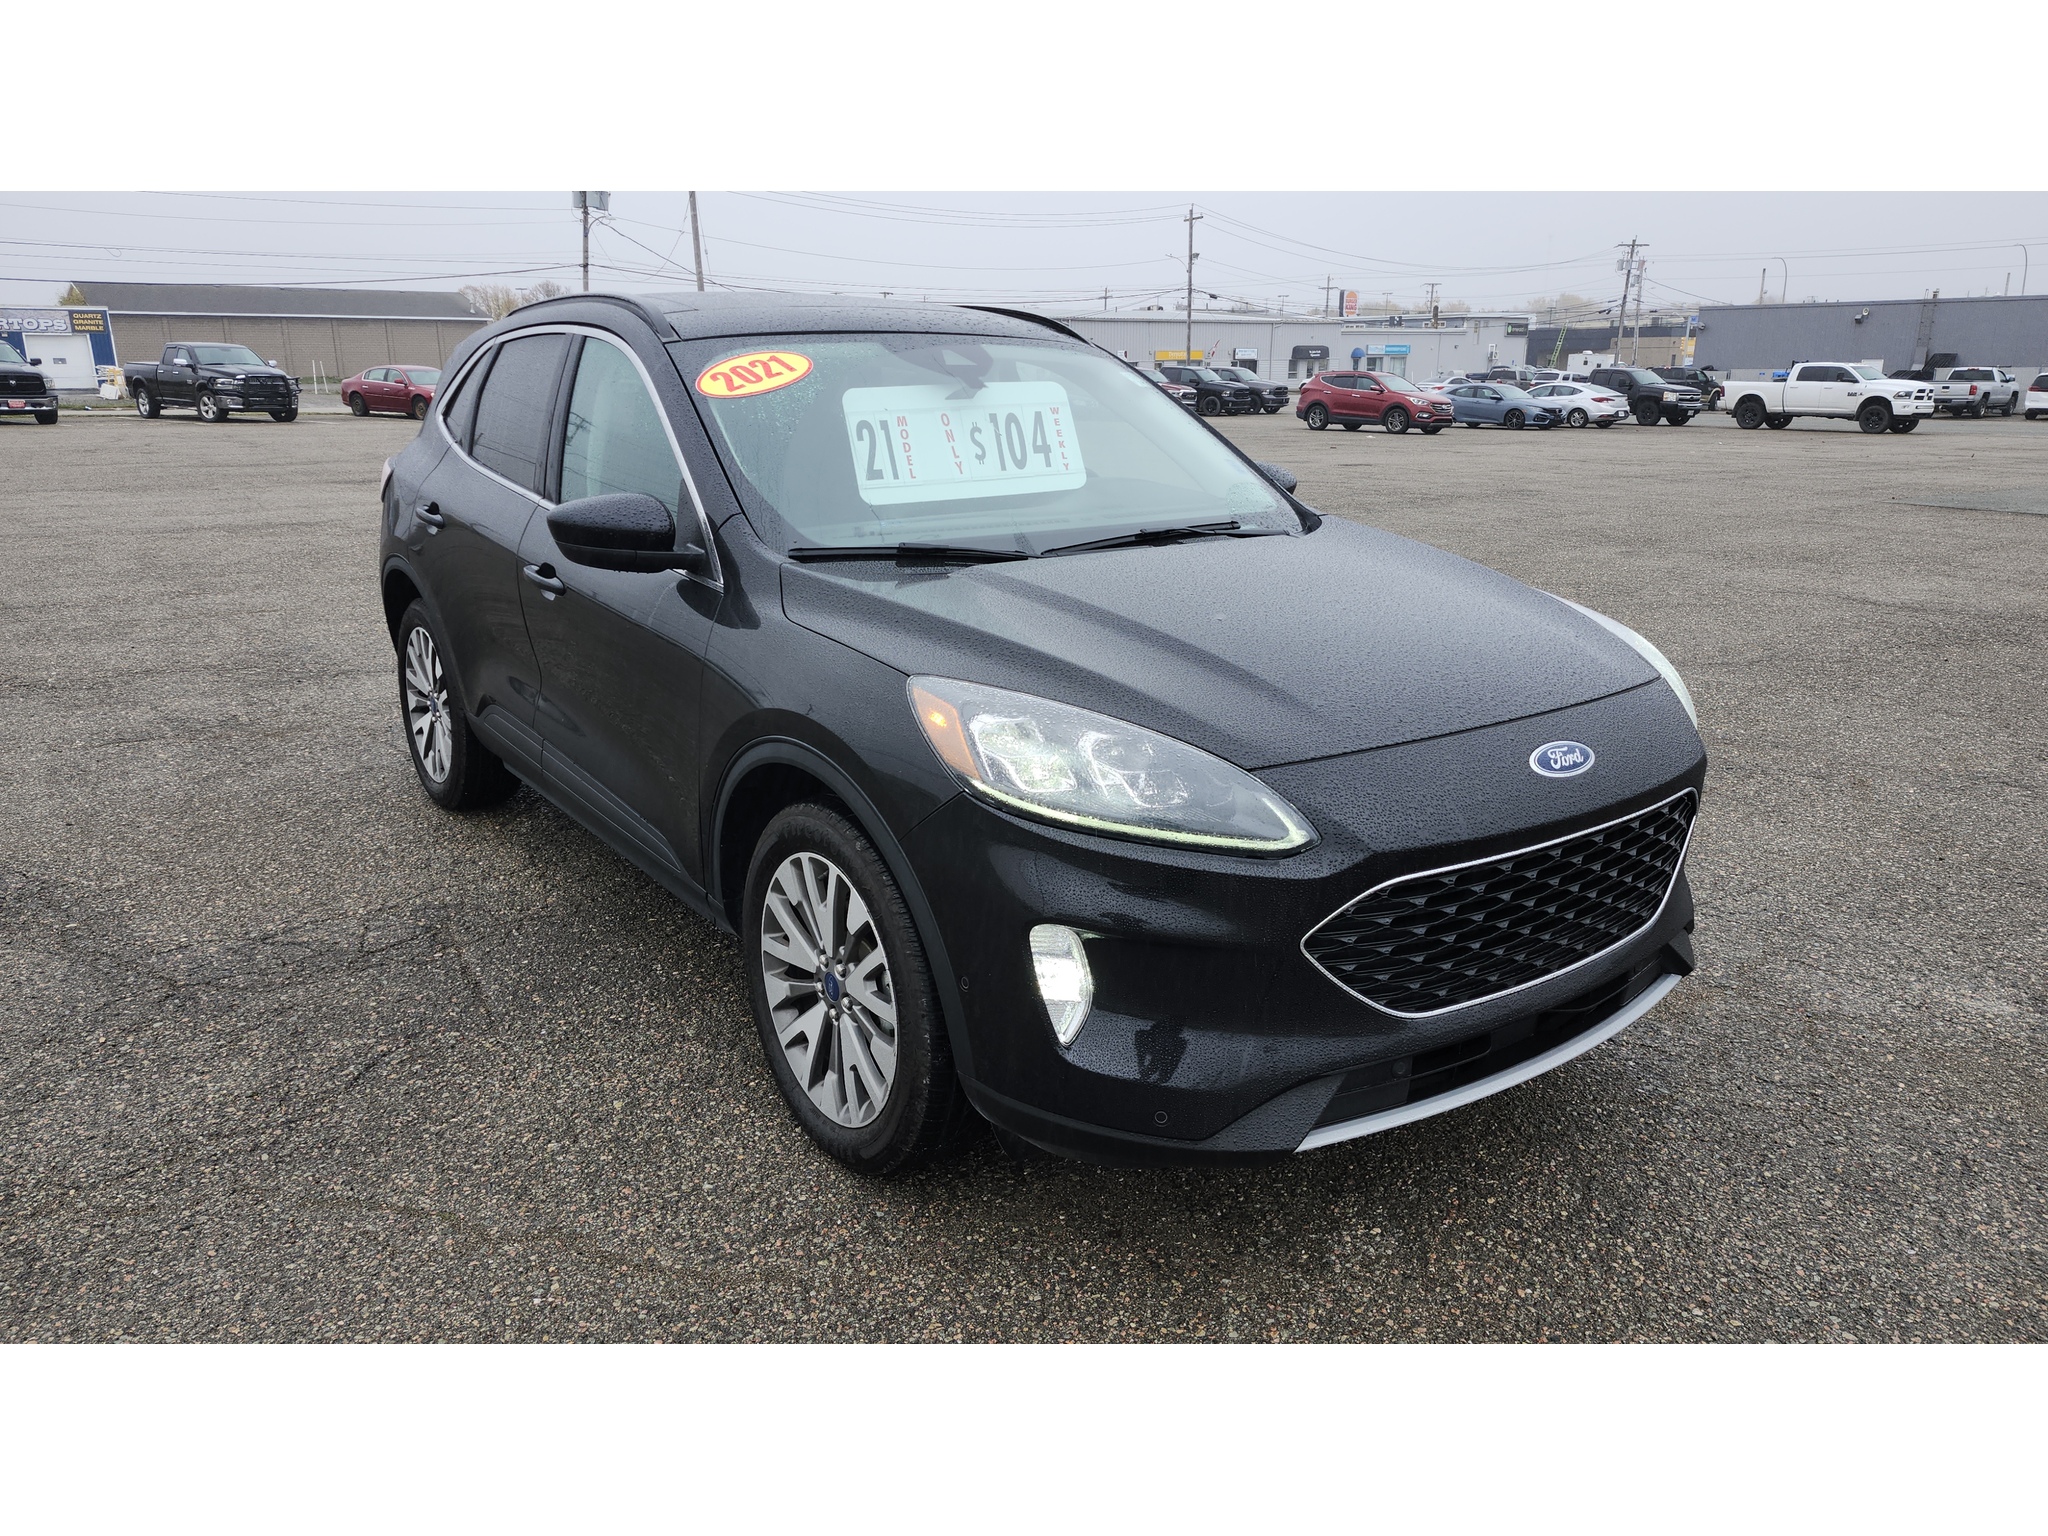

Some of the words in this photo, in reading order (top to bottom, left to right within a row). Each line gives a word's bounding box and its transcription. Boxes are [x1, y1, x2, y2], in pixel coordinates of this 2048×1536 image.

[709, 355, 797, 392] 2021
[855, 419, 900, 481] 21
[896, 415, 917, 480] MODEL
[940, 412, 964, 475] ONLY
[1049, 406, 1070, 471] WEEKLY
[1547, 746, 1584, 770] Ford
